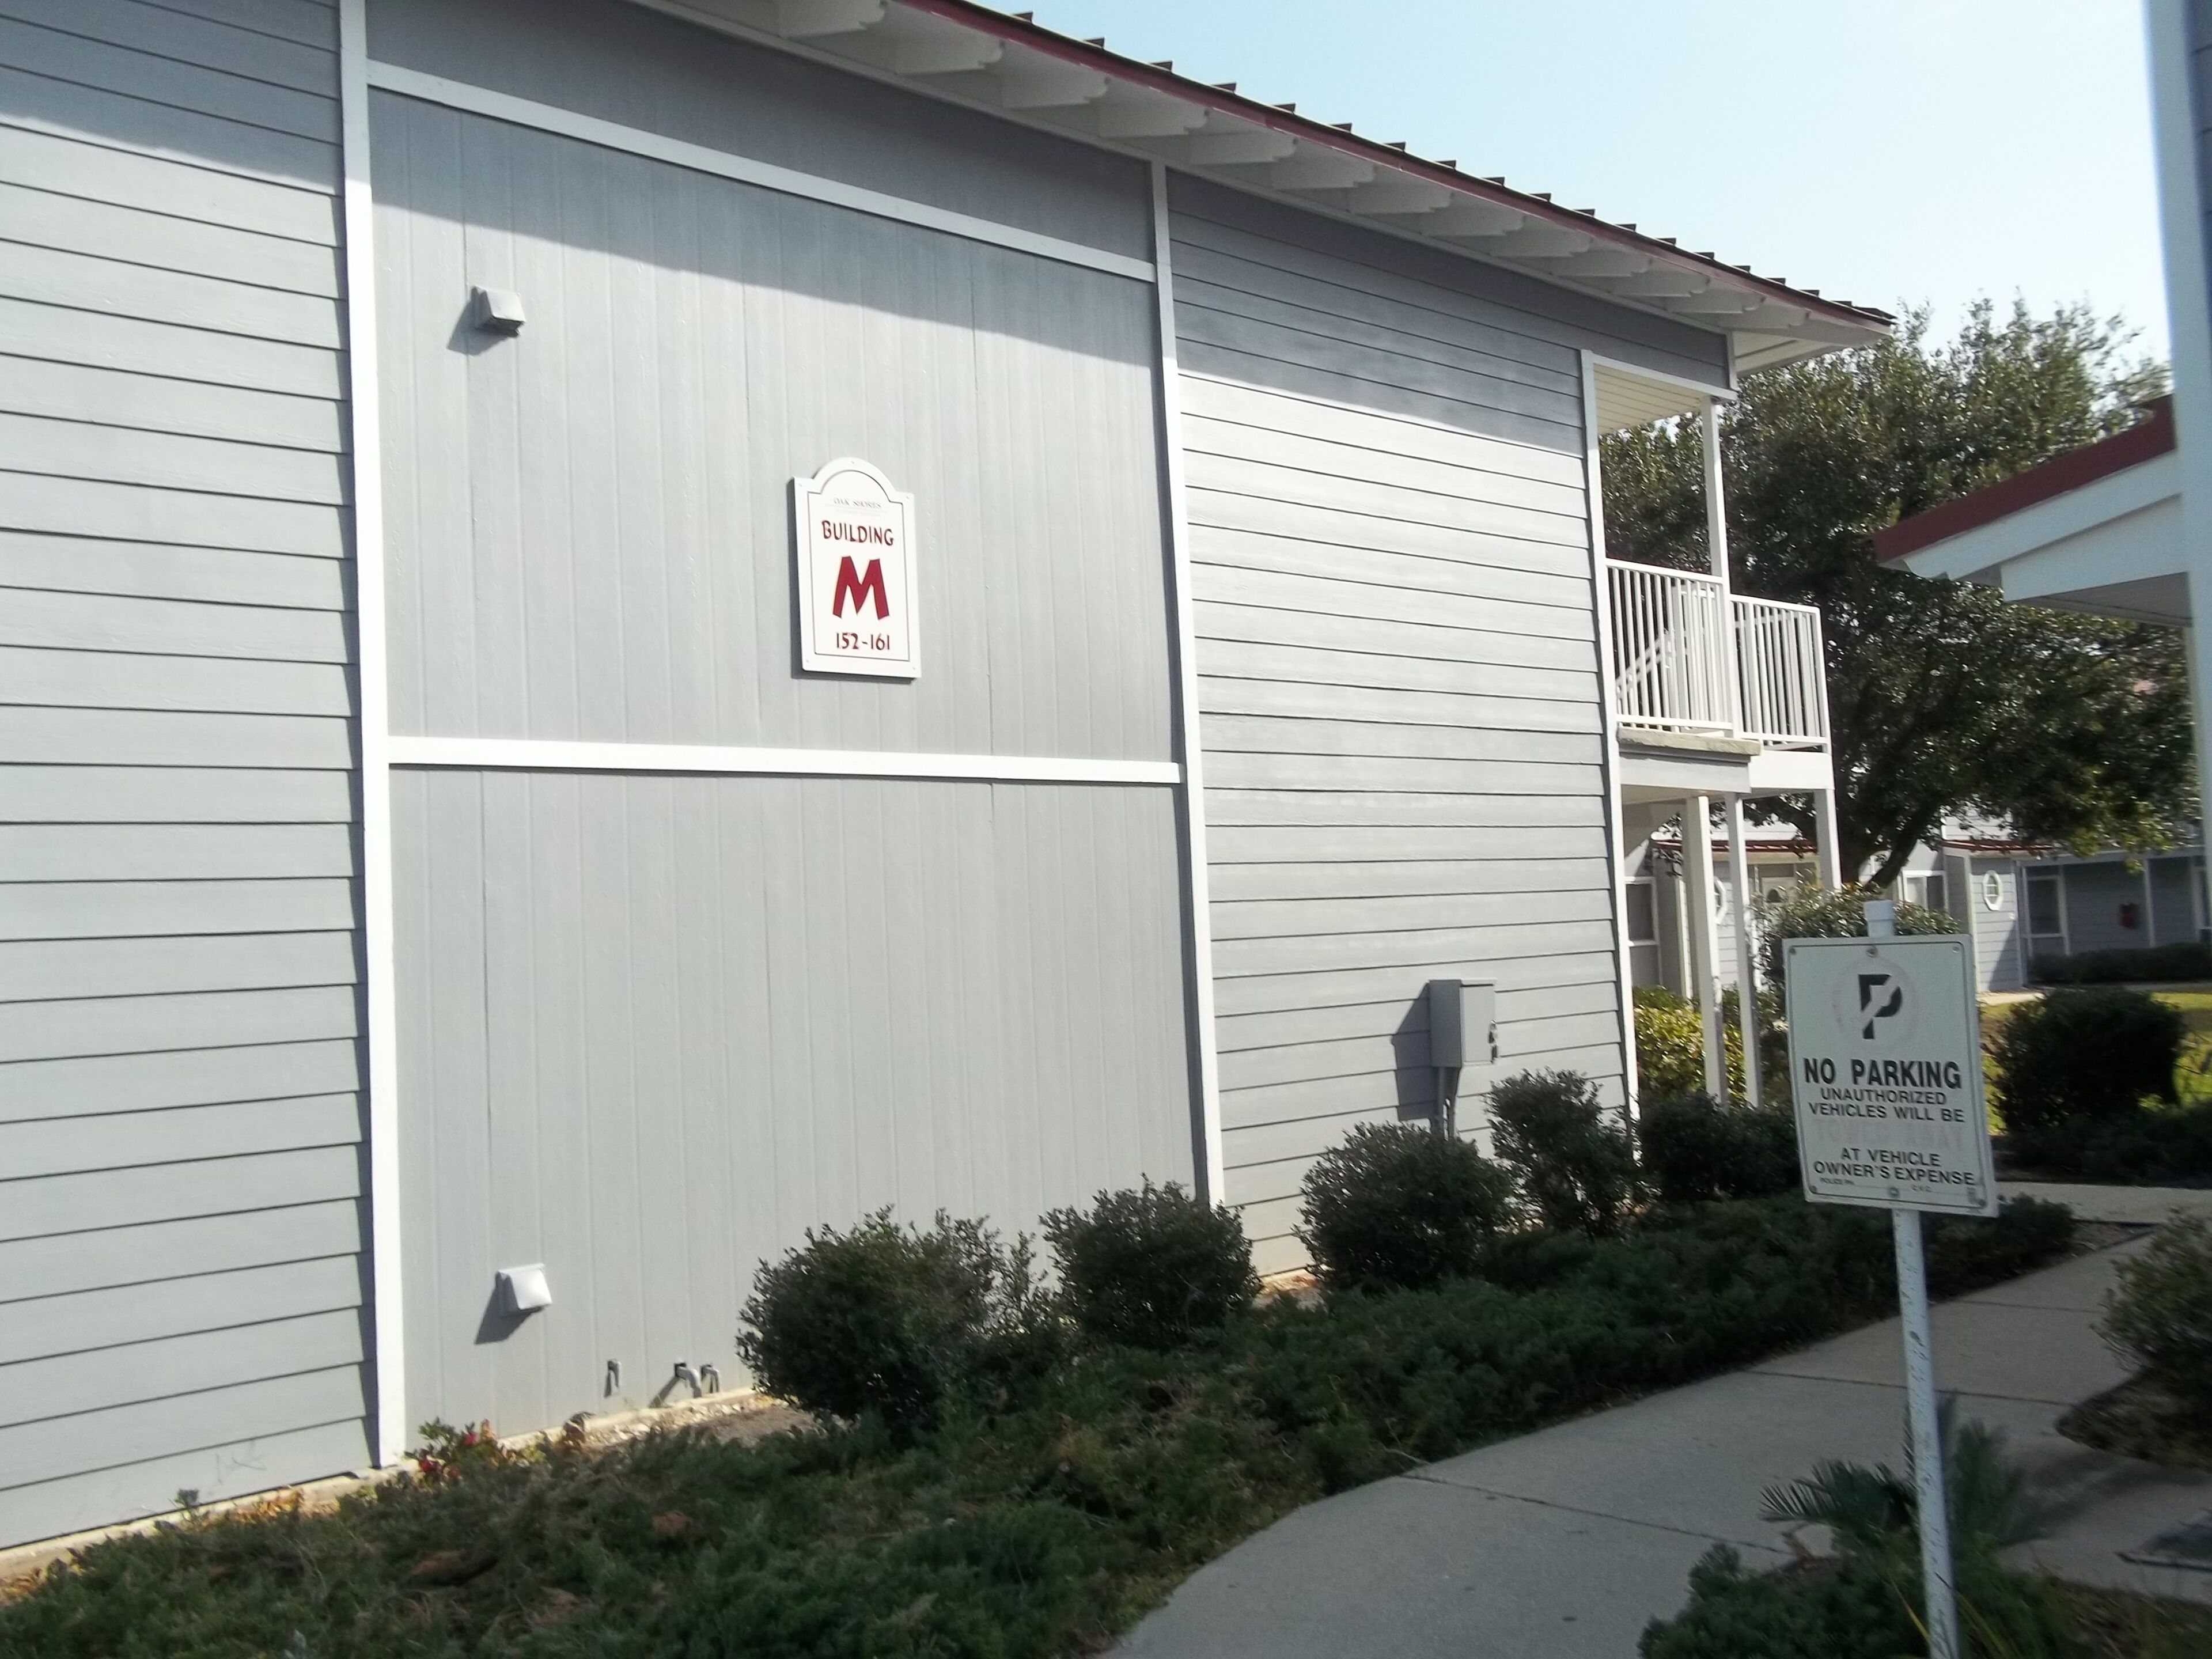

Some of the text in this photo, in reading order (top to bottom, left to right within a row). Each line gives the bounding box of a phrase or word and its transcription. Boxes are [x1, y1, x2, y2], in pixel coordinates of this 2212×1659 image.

[821, 520, 894, 546] BUILDING
[832, 556, 889, 620] M
[836, 632, 890, 650] 152-161
[1804, 1058, 1962, 1089] NO PARKING
[1820, 1087, 1947, 1105] UNAUTHORIZED
[1808, 1102, 1965, 1123] VEHICLES WILL BE
[1841, 1147, 1941, 1167] AT VEHICLE
[1814, 1161, 1976, 1186] OWNER'S EXPENSE
